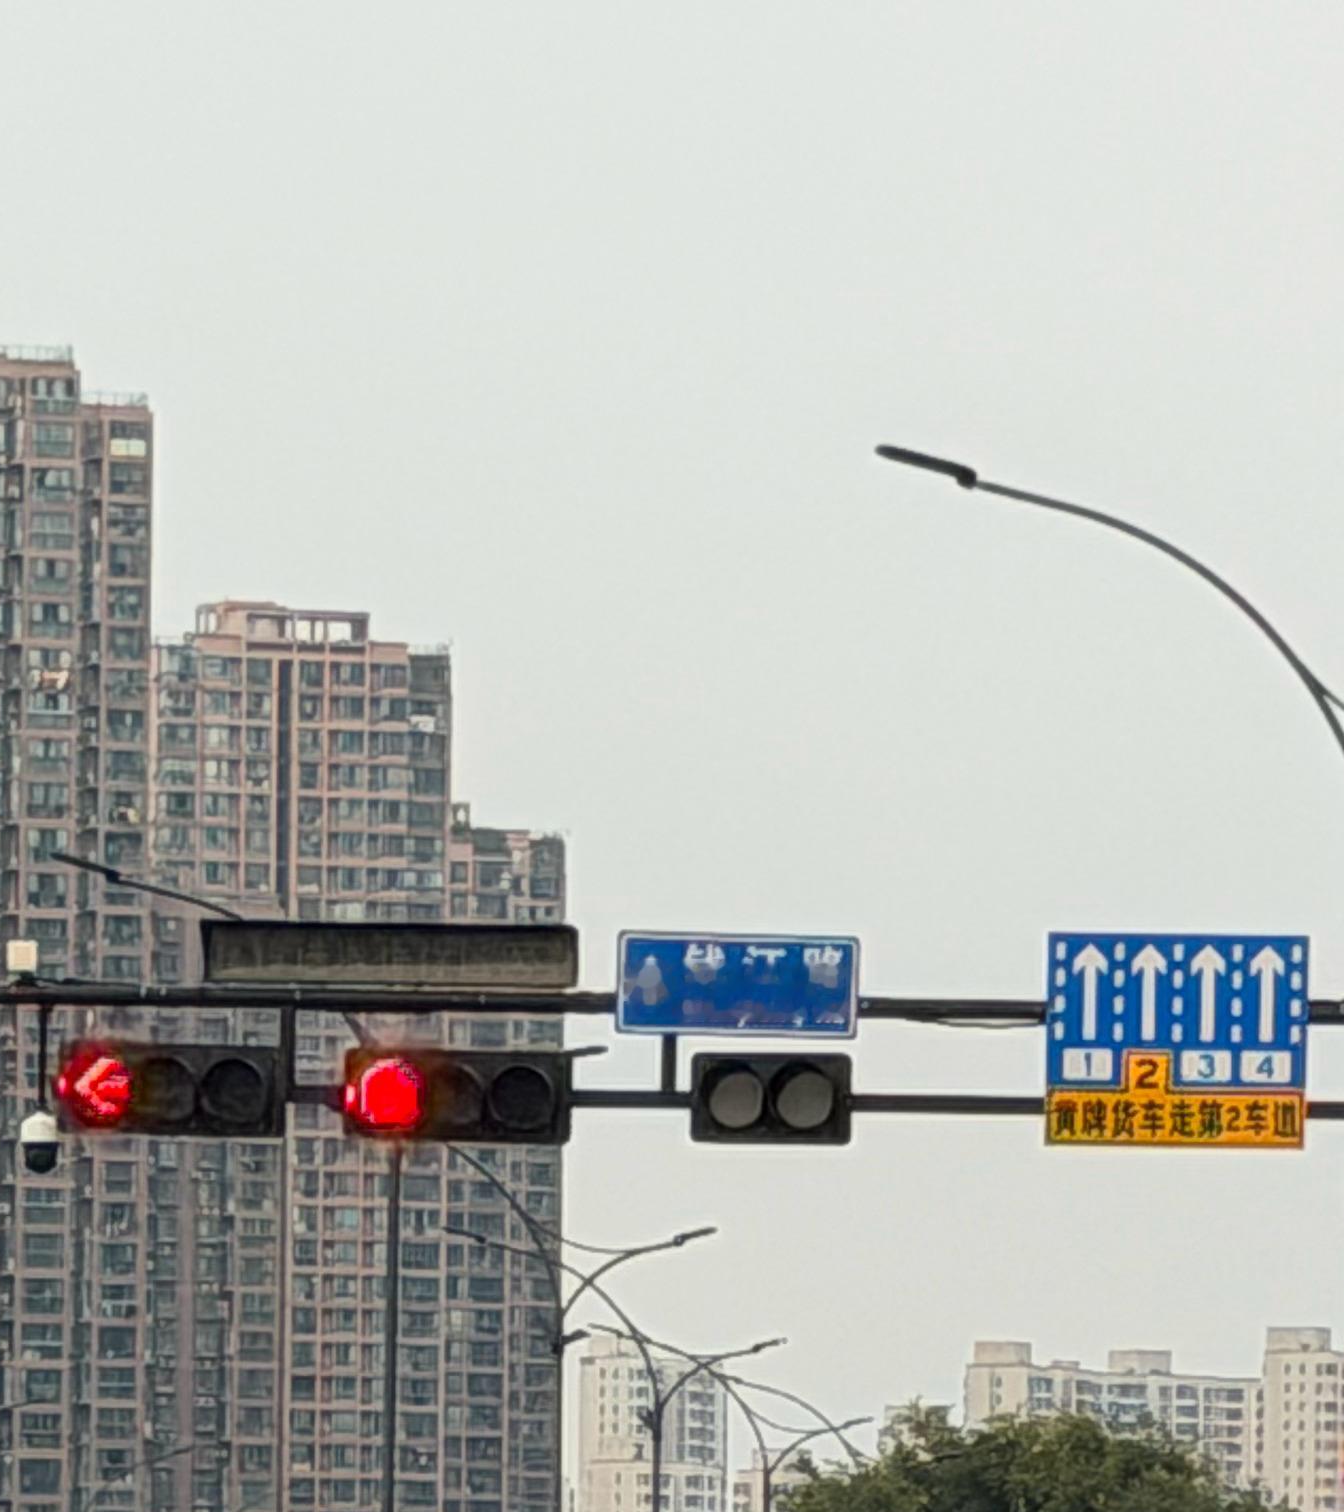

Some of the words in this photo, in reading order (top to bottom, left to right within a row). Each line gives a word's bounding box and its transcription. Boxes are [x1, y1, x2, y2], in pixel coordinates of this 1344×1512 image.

[1081, 1053, 1091, 1077] 1
[1135, 1058, 1159, 1089] 2
[1197, 1053, 1215, 1078] 3
[1255, 1055, 1274, 1079] 4
[1054, 1099, 1298, 1138] 黄牌货车走第2车道
